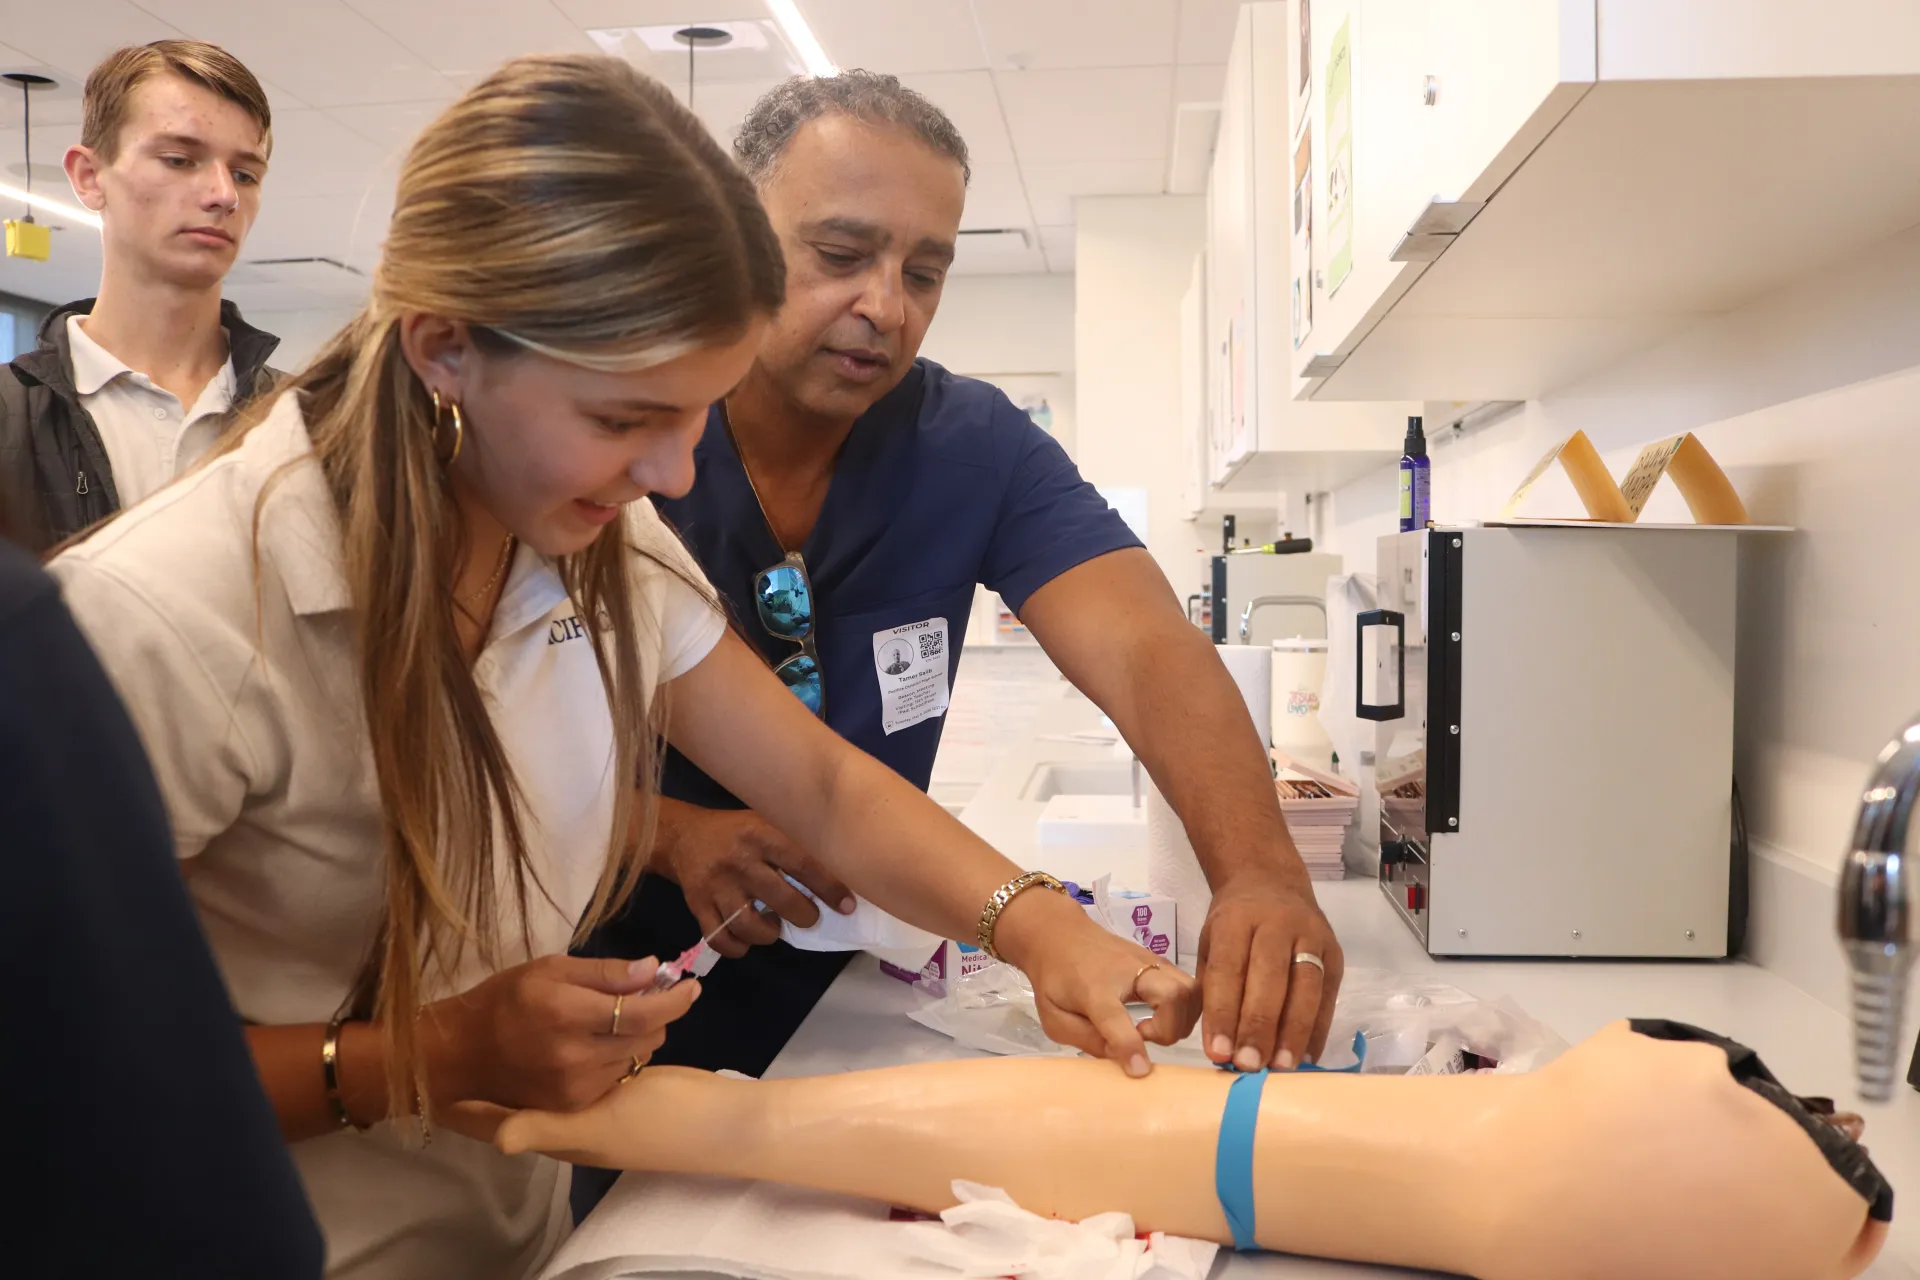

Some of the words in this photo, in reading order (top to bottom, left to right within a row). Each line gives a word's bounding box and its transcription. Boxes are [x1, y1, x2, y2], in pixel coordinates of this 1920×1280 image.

[893, 621, 930, 635] VISITOR
[1136, 907, 1148, 917] 100
[961, 953, 988, 963] Medica
